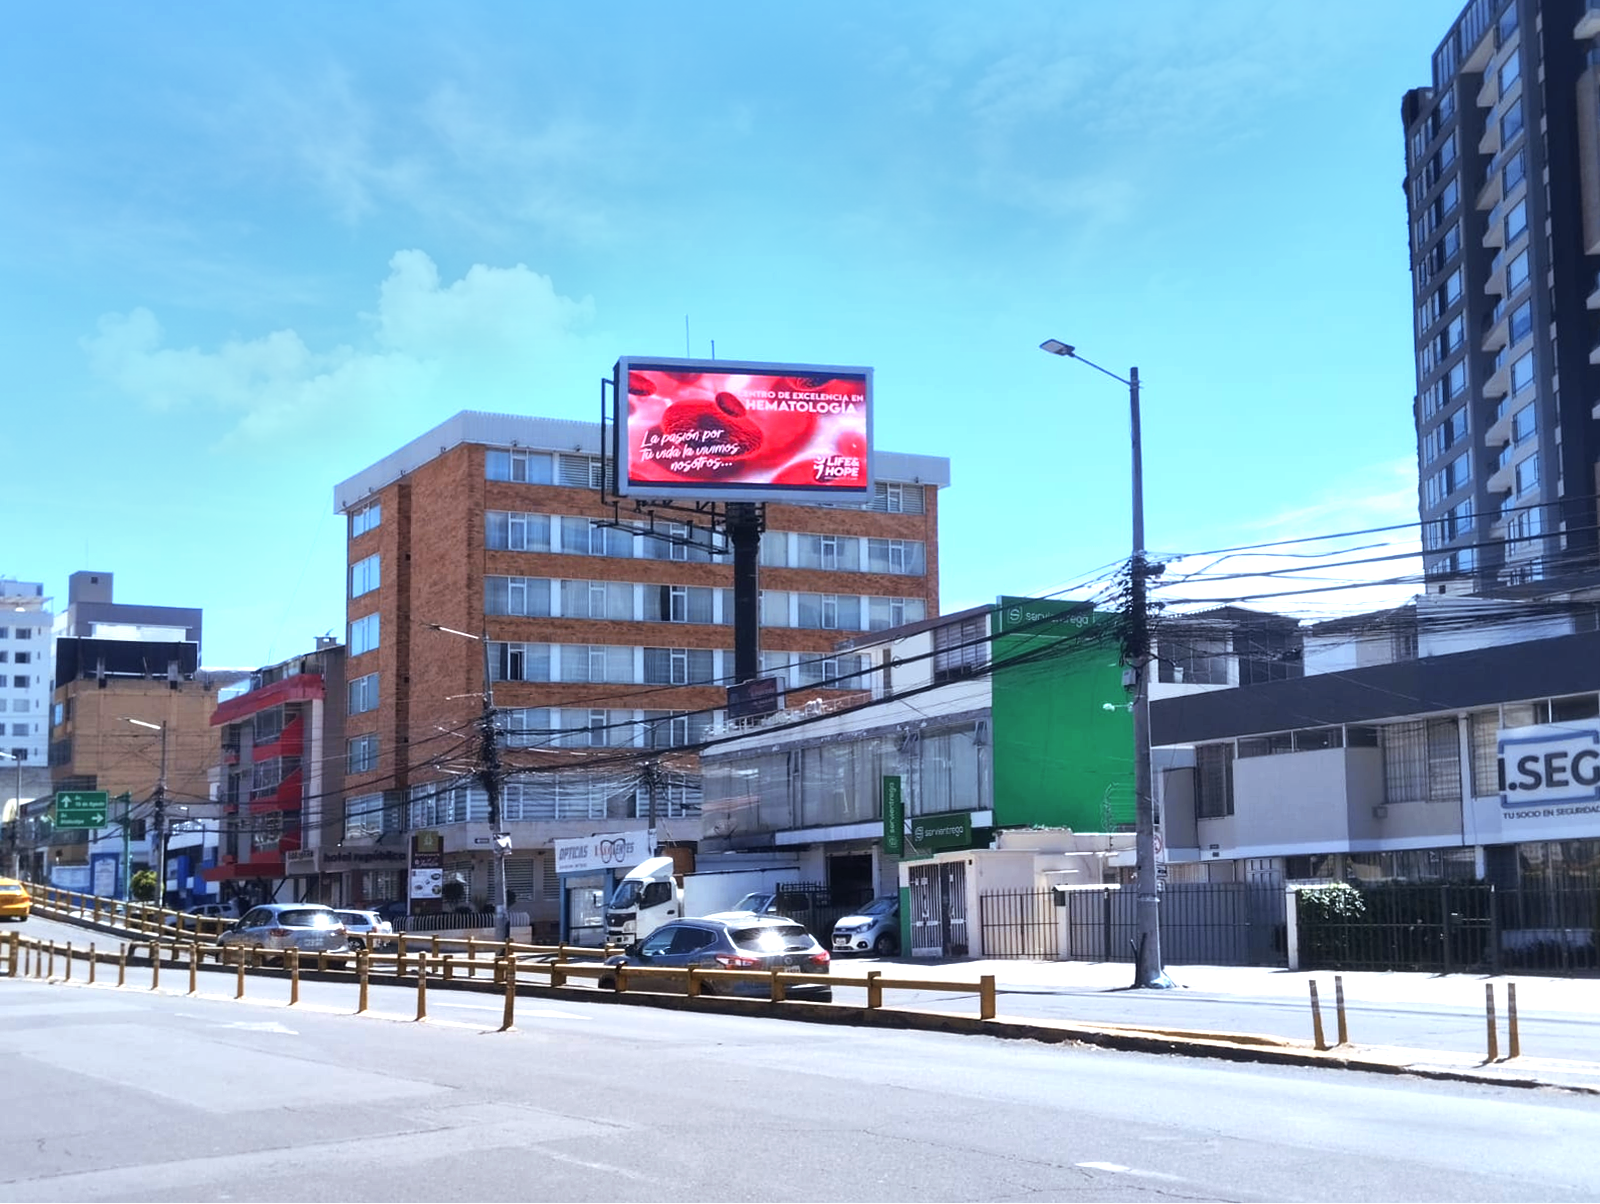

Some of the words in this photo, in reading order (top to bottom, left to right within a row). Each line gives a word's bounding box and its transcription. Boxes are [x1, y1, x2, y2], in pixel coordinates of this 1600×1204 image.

[777, 390, 791, 399] DE
[792, 391, 849, 402] EXCELENCIA
[851, 393, 864, 402] EN
[746, 398, 857, 413] HEMATOLOGÍA
[641, 430, 660, 448] La
[702, 429, 725, 443] por
[655, 445, 682, 460] vida
[682, 443, 696, 459] la
[696, 442, 741, 455] vivimos
[824, 466, 860, 477] HOPE
[1516, 811, 1541, 819] SOCIO
[1543, 809, 1554, 817] EN
